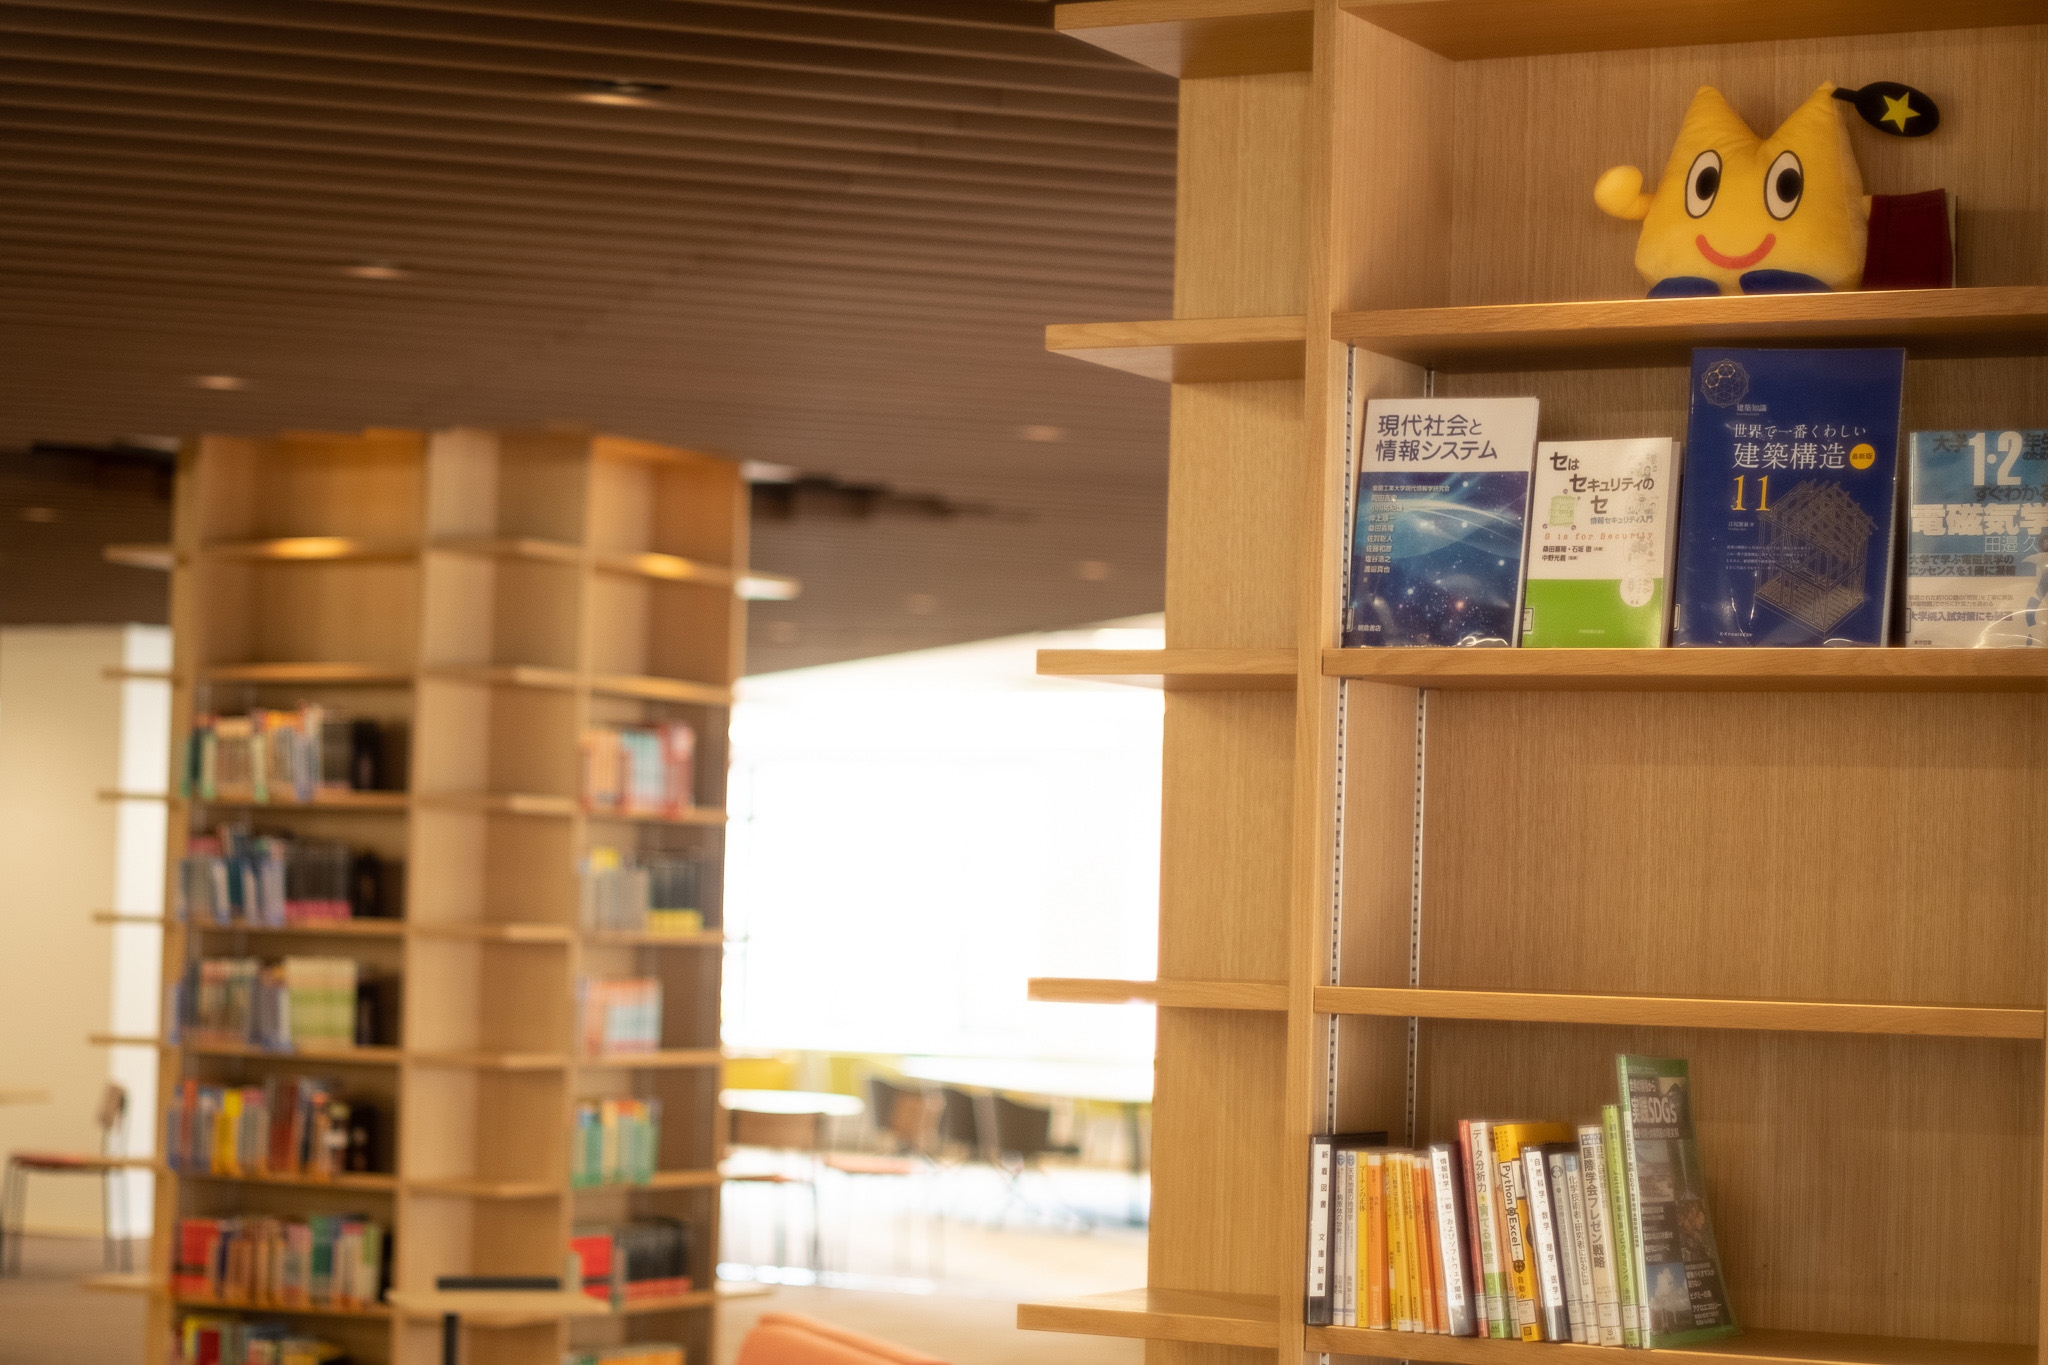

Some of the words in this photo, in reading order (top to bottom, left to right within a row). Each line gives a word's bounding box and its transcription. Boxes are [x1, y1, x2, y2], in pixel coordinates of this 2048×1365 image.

[1377, 413, 1482, 437] 現代社会と
[1733, 423, 1867, 439] 世界で一番くわしい
[1375, 439, 1498, 462] 情報システム
[1549, 451, 1580, 471] セは
[1732, 442, 1846, 470] 建築構造
[1569, 473, 1655, 493] セキュリティの
[1731, 474, 1771, 511] 11
[1590, 494, 1608, 514] セ
[1590, 515, 1653, 525] 情報セキュリティ入門
[1911, 502, 2048, 536] 電磁気学
[1575, 532, 1594, 540] for
[1600, 532, 1653, 542] Security
[1908, 565, 2016, 577] エッセンスを1冊に凝縮
[1909, 554, 2014, 566] 大学で学ぶ電磁気学の
[1320, 1150, 1329, 1209] 新着図書
[1359, 1164, 1367, 1212] プーチンの正体
[1473, 1129, 1494, 1265] データ分析力を育てる教室
[1501, 1164, 1513, 1208] Python
[1508, 1217, 1520, 1246] Excel
[1583, 1146, 1606, 1269] 国際学会プレゼン戦略
[1316, 1232, 1325, 1292] 文庫新書
